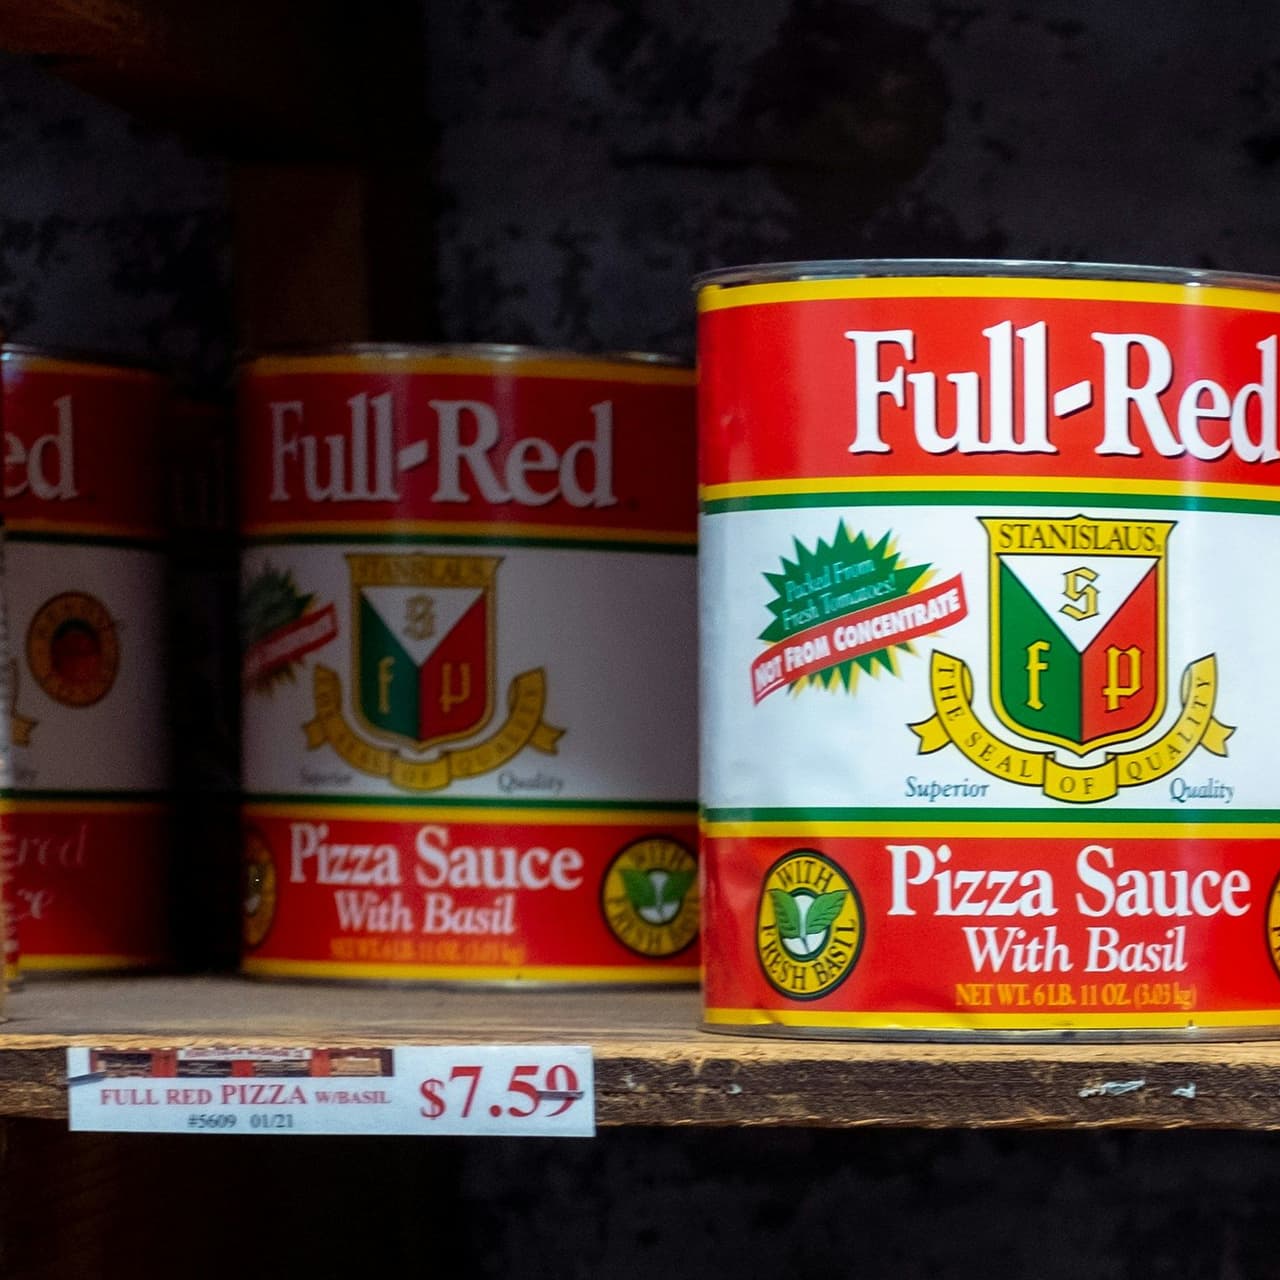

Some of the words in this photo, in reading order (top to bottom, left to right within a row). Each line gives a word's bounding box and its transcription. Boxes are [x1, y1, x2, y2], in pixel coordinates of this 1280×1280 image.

[270, 391, 618, 507] Full-Red
[999, 524, 1158, 554] STANISLAUS
[754, 649, 782, 685] NOT
[784, 629, 831, 666] FROM
[832, 588, 961, 649] CONCENTRATE
[905, 776, 990, 801] Superior
[1169, 778, 1235, 804] Quality
[289, 824, 399, 884] Pizza
[417, 826, 584, 888] Sauce
[776, 862, 832, 894] WITH
[886, 843, 1056, 918] Pizza
[1075, 845, 1251, 918] Sauce
[335, 891, 411, 932] With
[423, 891, 515, 935] Basil
[761, 922, 809, 991] FRESH
[812, 916, 856, 989] BASIL
[961, 926, 1071, 972] With
[1083, 926, 1188, 974] Basil
[101, 1088, 160, 1105] FULL
[168, 1088, 211, 1105] RED
[221, 1084, 307, 1105] PIZZA
[316, 1090, 391, 1104] W/BASIL
[419, 1063, 579, 1118] $7.59
[187, 1114, 237, 1129] #5609
[250, 1114, 293, 1129] 01/21
